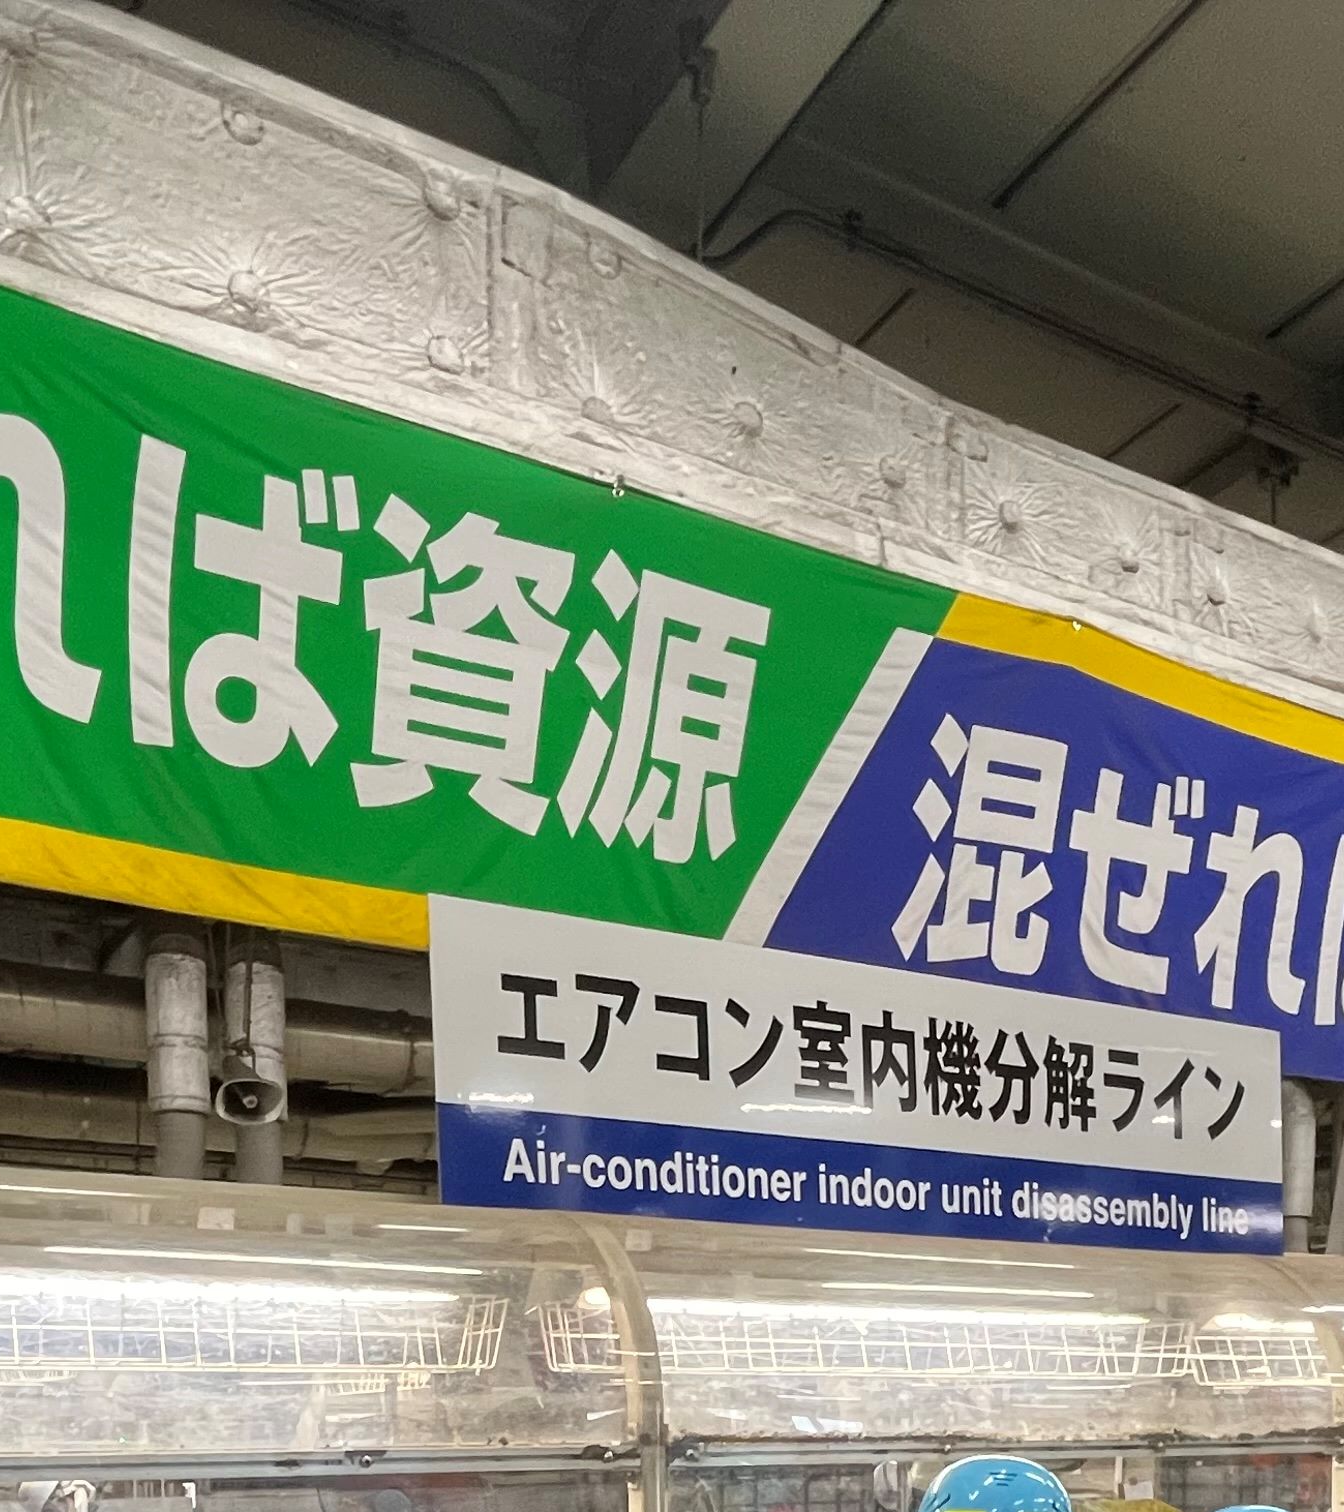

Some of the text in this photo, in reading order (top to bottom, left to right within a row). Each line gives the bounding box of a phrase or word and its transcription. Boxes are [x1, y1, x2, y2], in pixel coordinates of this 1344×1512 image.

[497, 973, 1245, 1140] エアコン室内機分解ライン
[503, 1137, 1249, 1240] Air-conditioner indoor unit disassembly line
